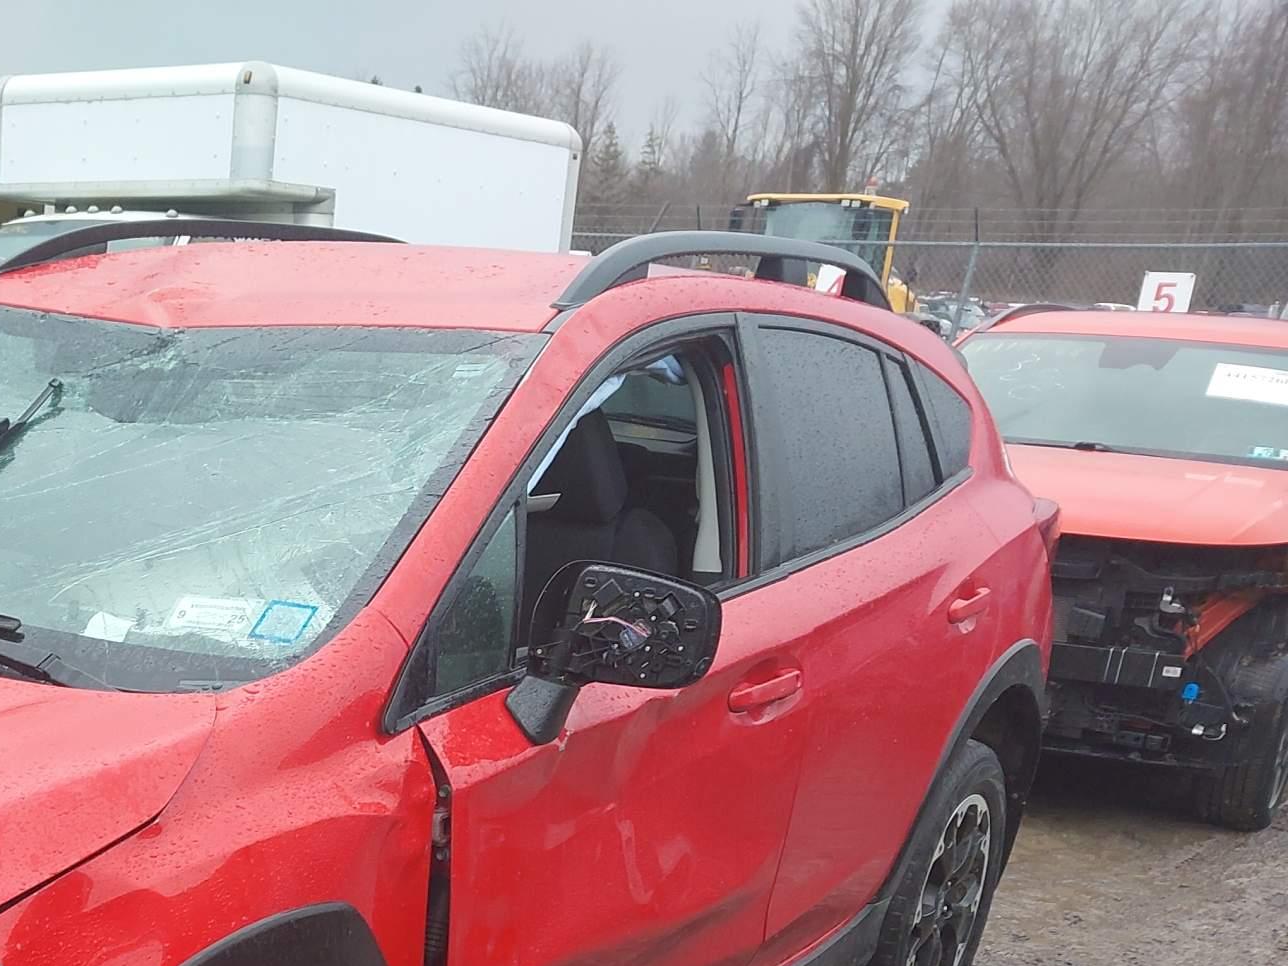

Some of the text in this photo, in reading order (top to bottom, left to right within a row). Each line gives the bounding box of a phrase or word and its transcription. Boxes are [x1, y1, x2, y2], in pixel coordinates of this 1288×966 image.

[1152, 282, 1177, 313] 5
[176, 609, 187, 619] 9
[226, 614, 247, 624] 25
